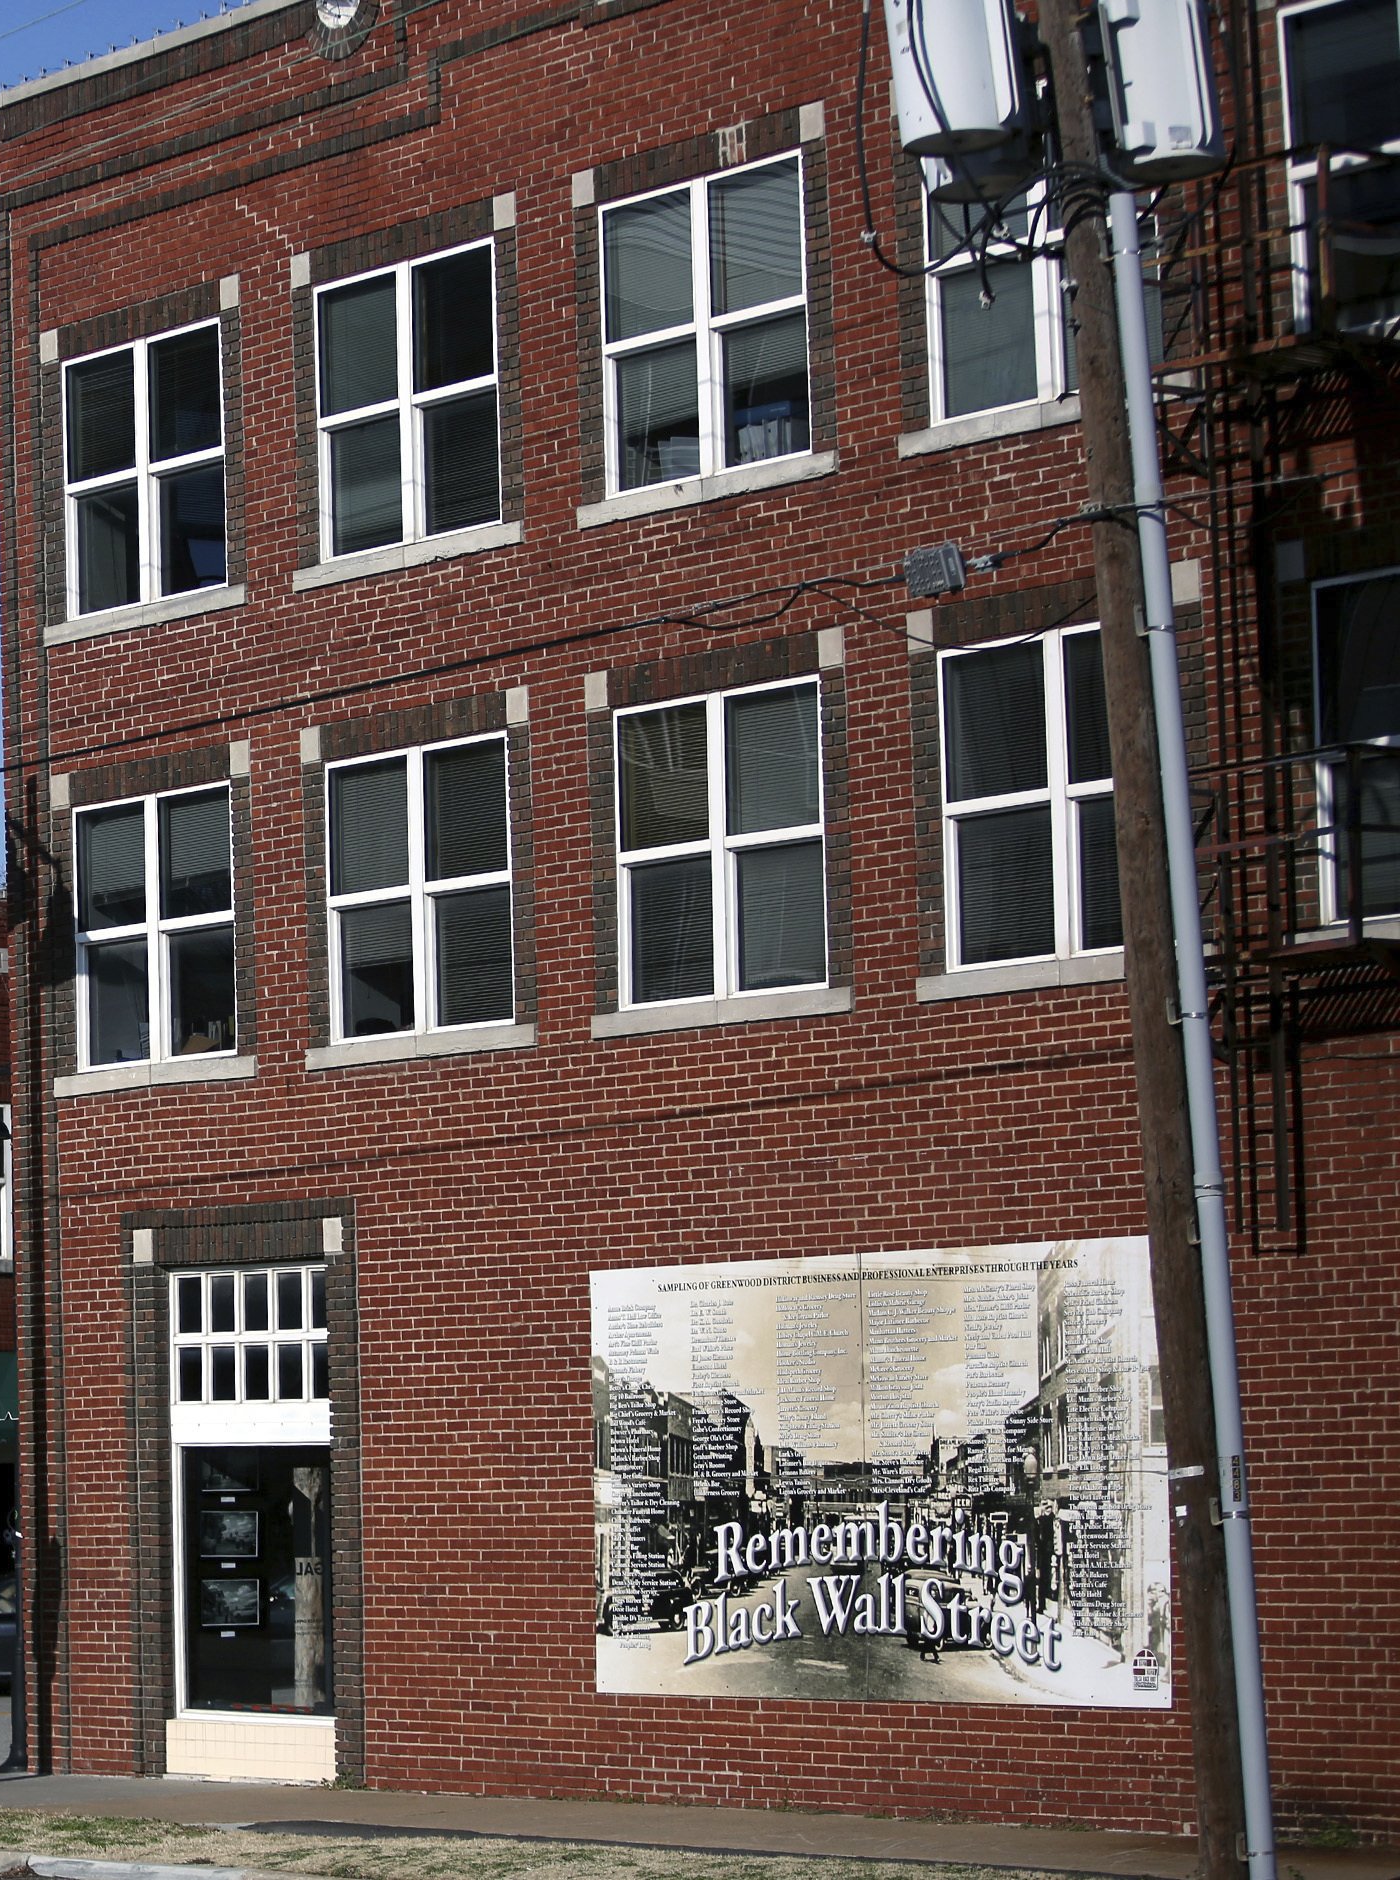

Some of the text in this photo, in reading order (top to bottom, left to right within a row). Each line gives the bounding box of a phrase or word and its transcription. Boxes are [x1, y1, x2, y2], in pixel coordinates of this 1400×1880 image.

[658, 1259, 1078, 1292] SAMPLING OF GREENWOOD DISTRICT BUSINESS AND PROFESSIONAL ENTERPRISES THROUGH THE YEARS
[1010, 1417, 1026, 1426] Sunny
[713, 1500, 1024, 1604] Remembering
[682, 1572, 1062, 1671] Black Wall Street
